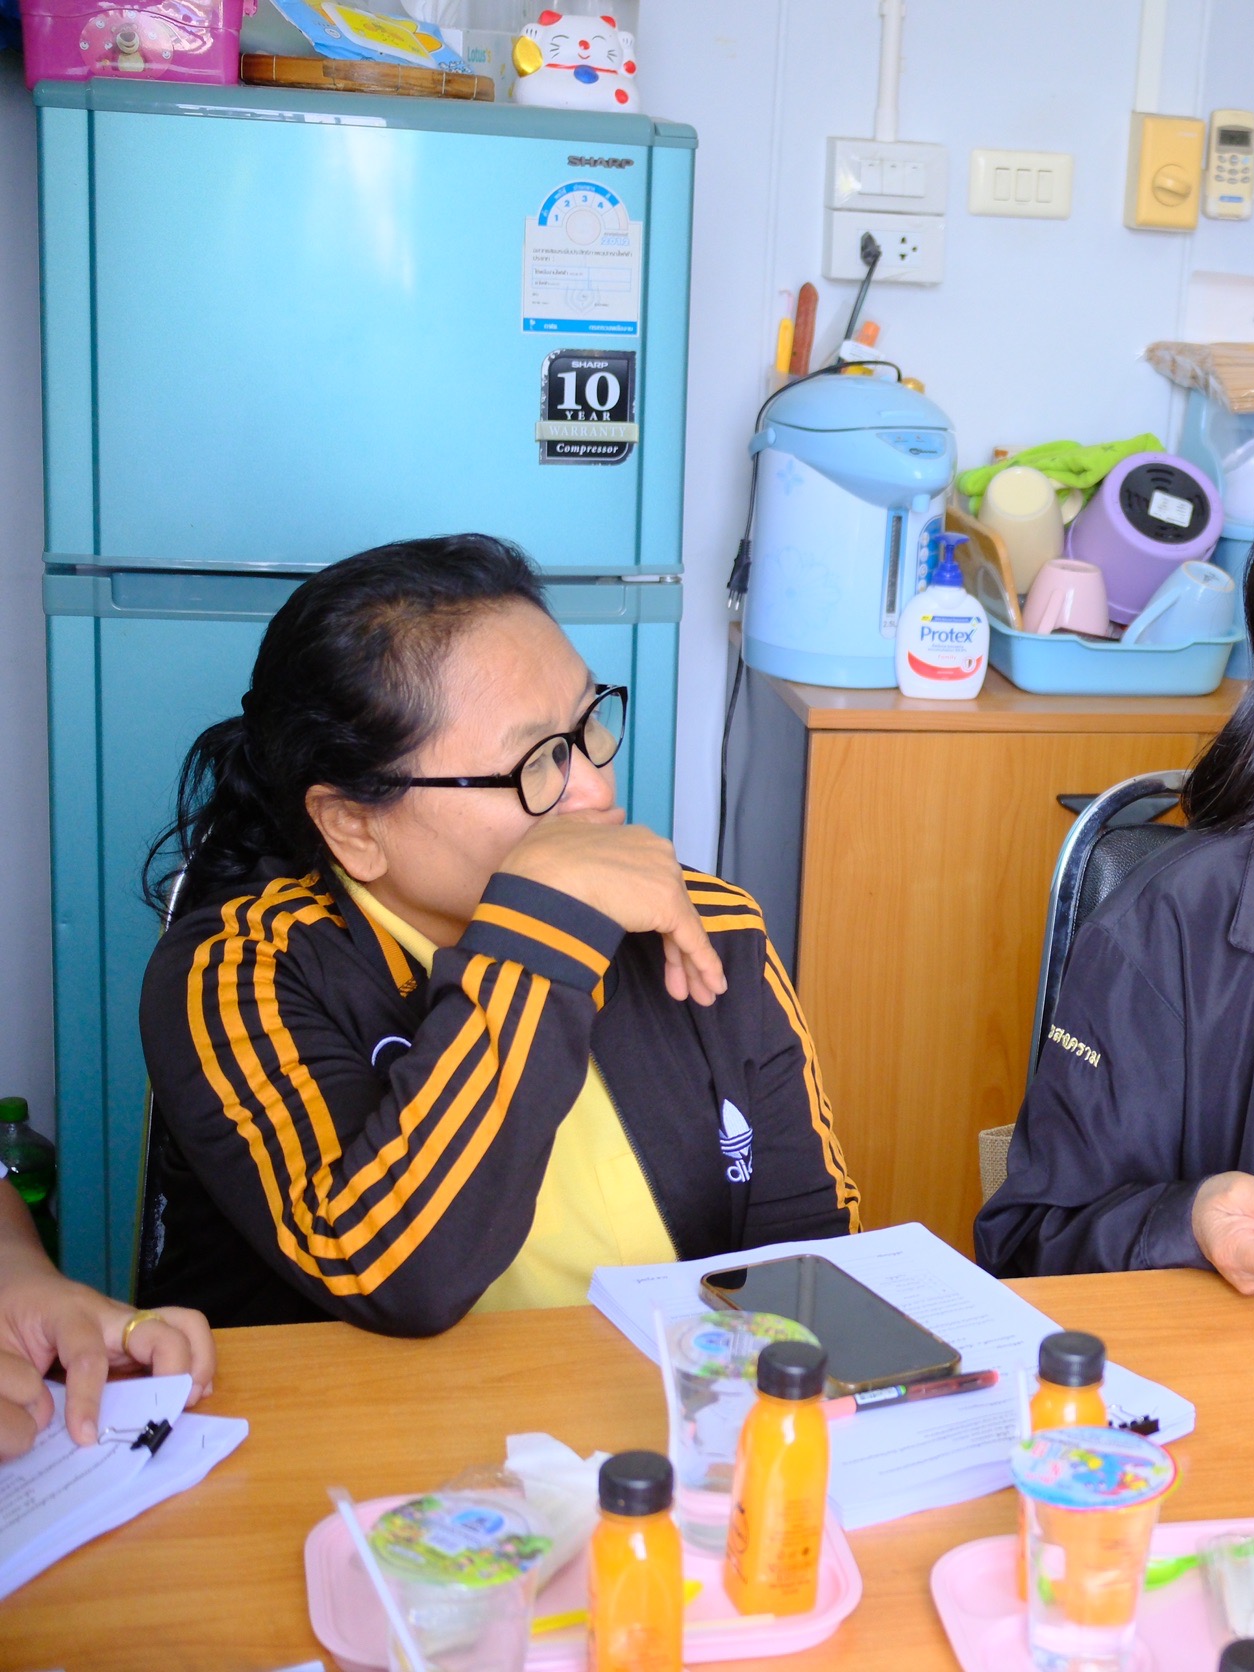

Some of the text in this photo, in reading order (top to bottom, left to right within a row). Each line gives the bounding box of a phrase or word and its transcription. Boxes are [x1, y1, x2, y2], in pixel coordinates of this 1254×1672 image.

[567, 155, 635, 169] SHARP
[554, 214, 560, 222] 1
[563, 200, 571, 208] 2
[581, 195, 588, 203] 3
[571, 361, 609, 369] SHARP
[556, 370, 621, 411] 10
[565, 411, 611, 421] YEAR
[548, 426, 626, 438] WARRANTY
[556, 443, 619, 455] Compressor
[920, 625, 974, 643] Protex
